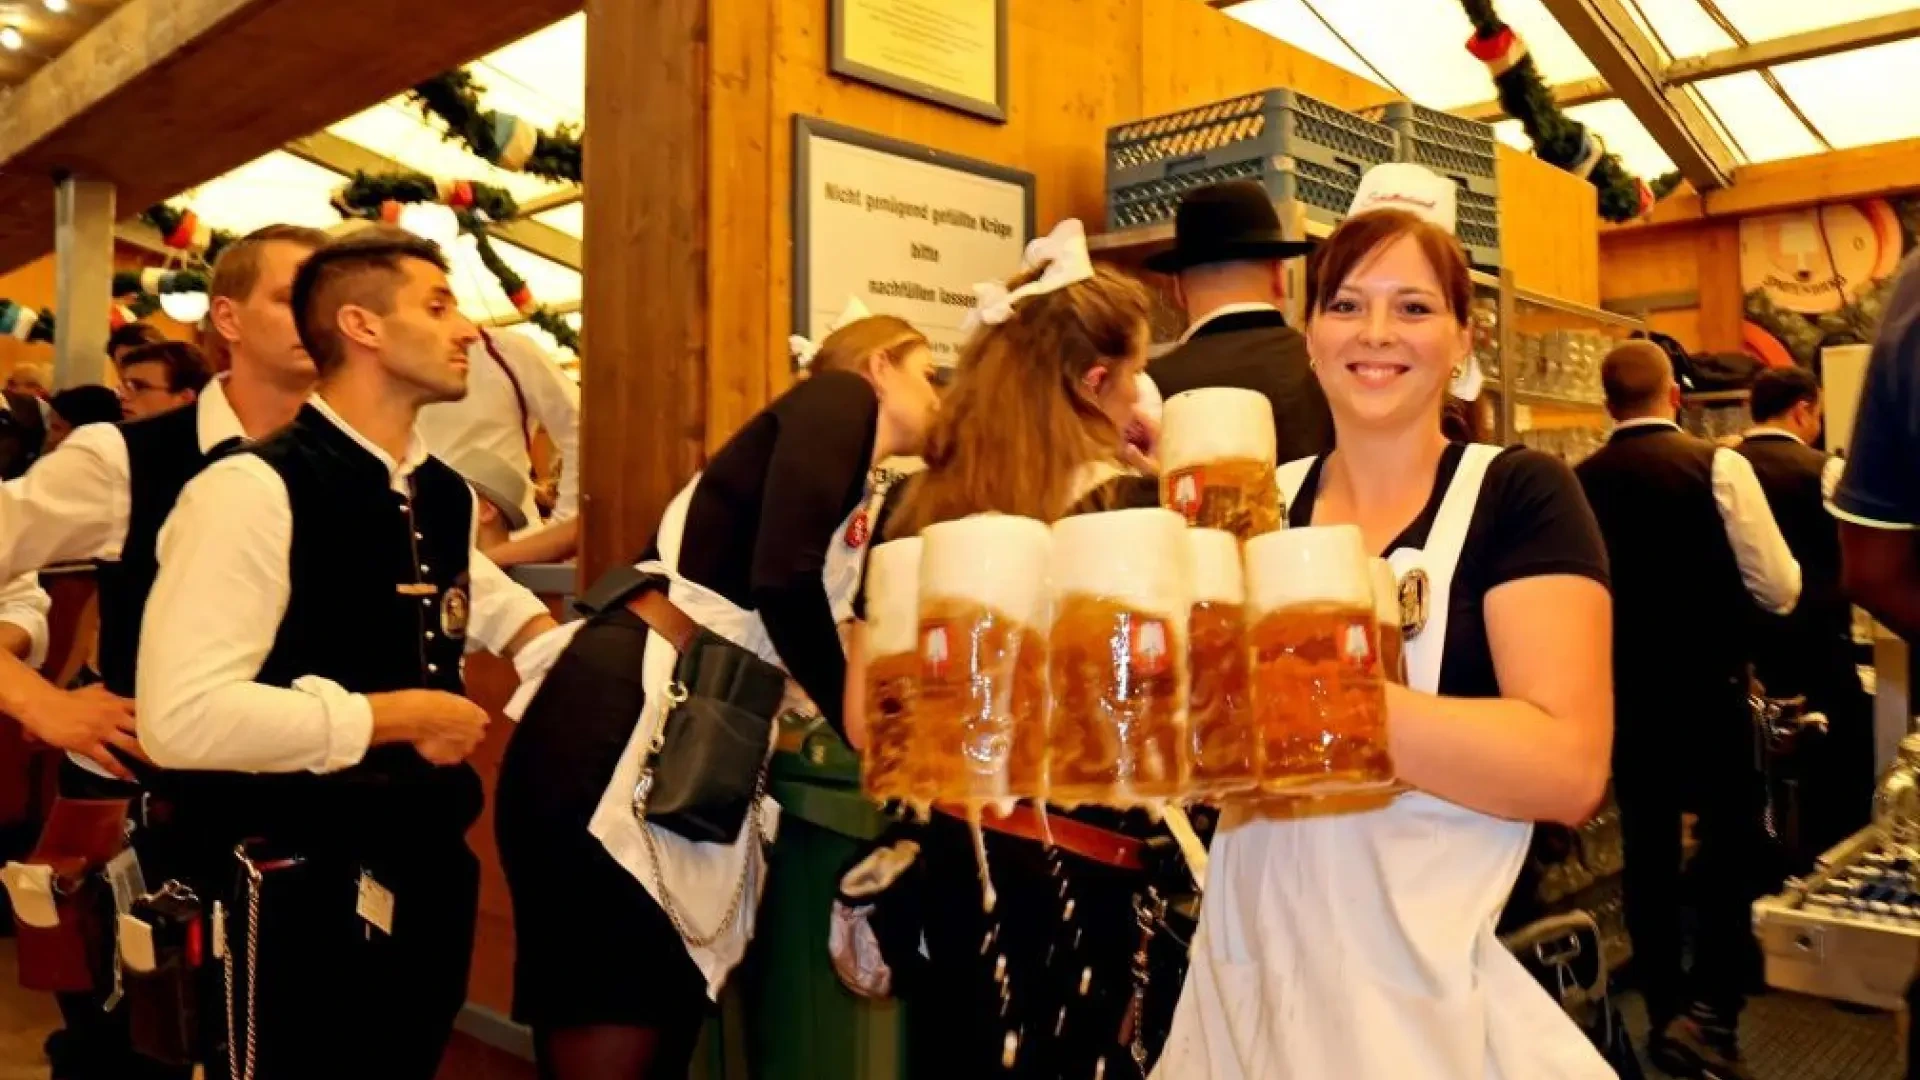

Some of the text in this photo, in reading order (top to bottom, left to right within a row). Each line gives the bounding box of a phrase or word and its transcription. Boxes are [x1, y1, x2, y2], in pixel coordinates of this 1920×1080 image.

[824, 181, 1013, 239] Nicht genügend gefüllte Krüge
[910, 242, 940, 263] bitte
[868, 279, 978, 308] nachfüllen lassen
